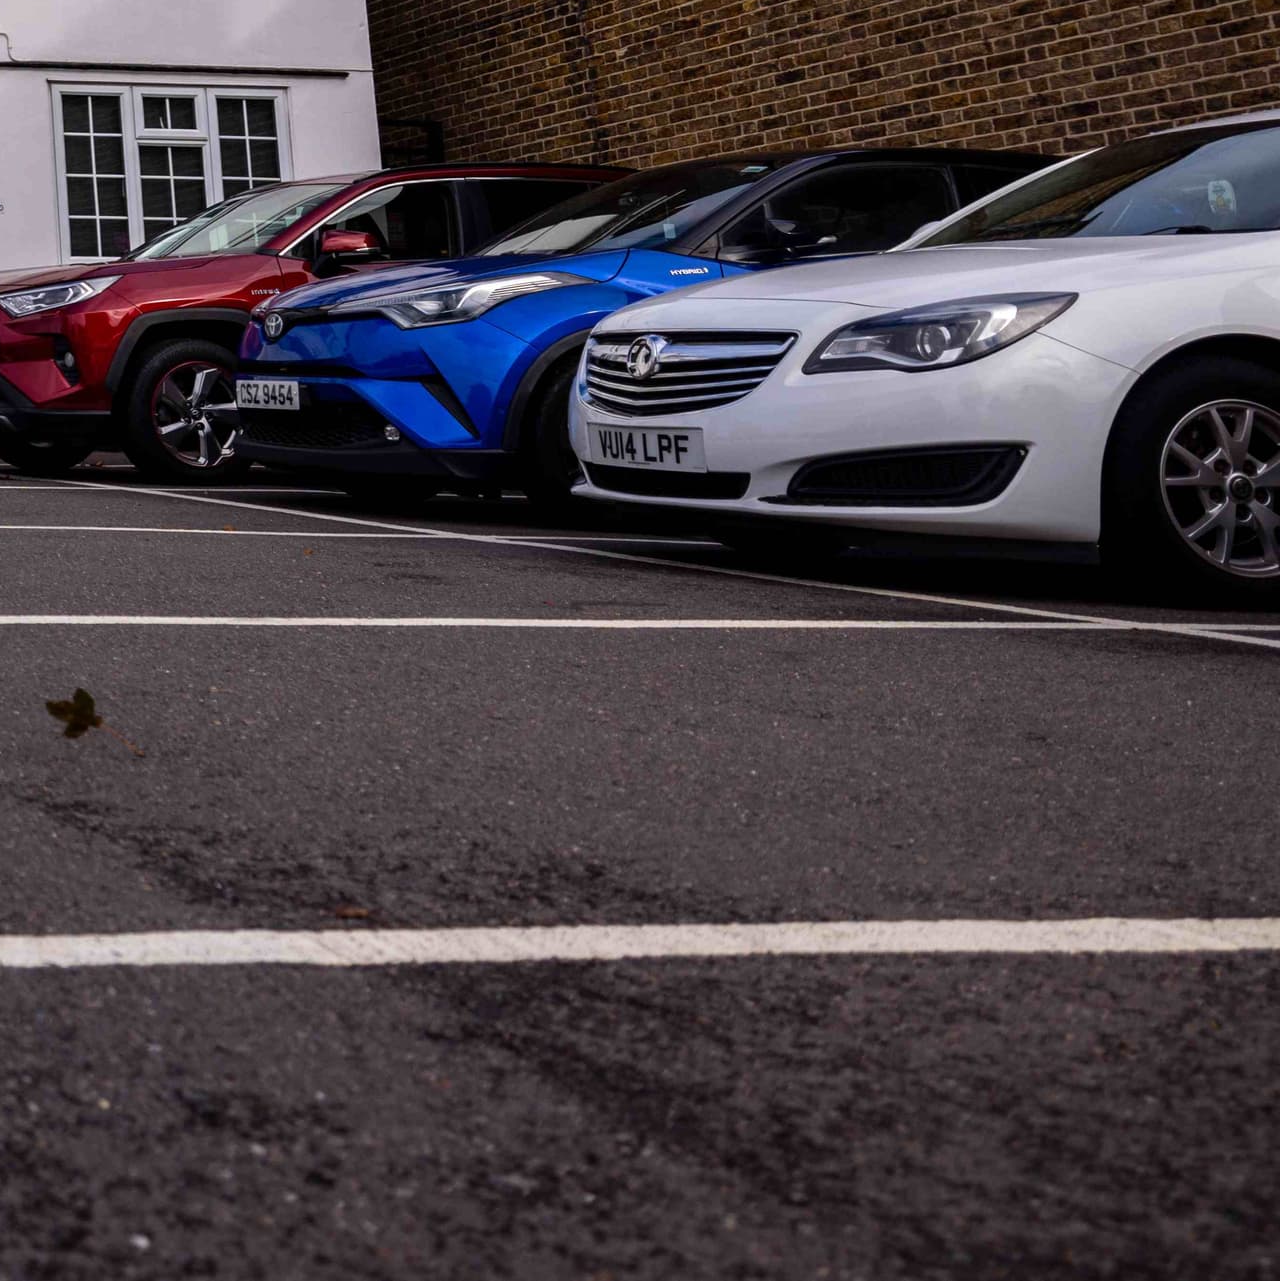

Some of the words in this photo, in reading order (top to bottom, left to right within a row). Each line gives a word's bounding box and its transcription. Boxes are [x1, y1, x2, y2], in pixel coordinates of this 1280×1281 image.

[240, 383, 260, 404] CSZ
[263, 384, 293, 405] 9454
[598, 430, 637, 460] VU14
[641, 432, 689, 464] LPF
